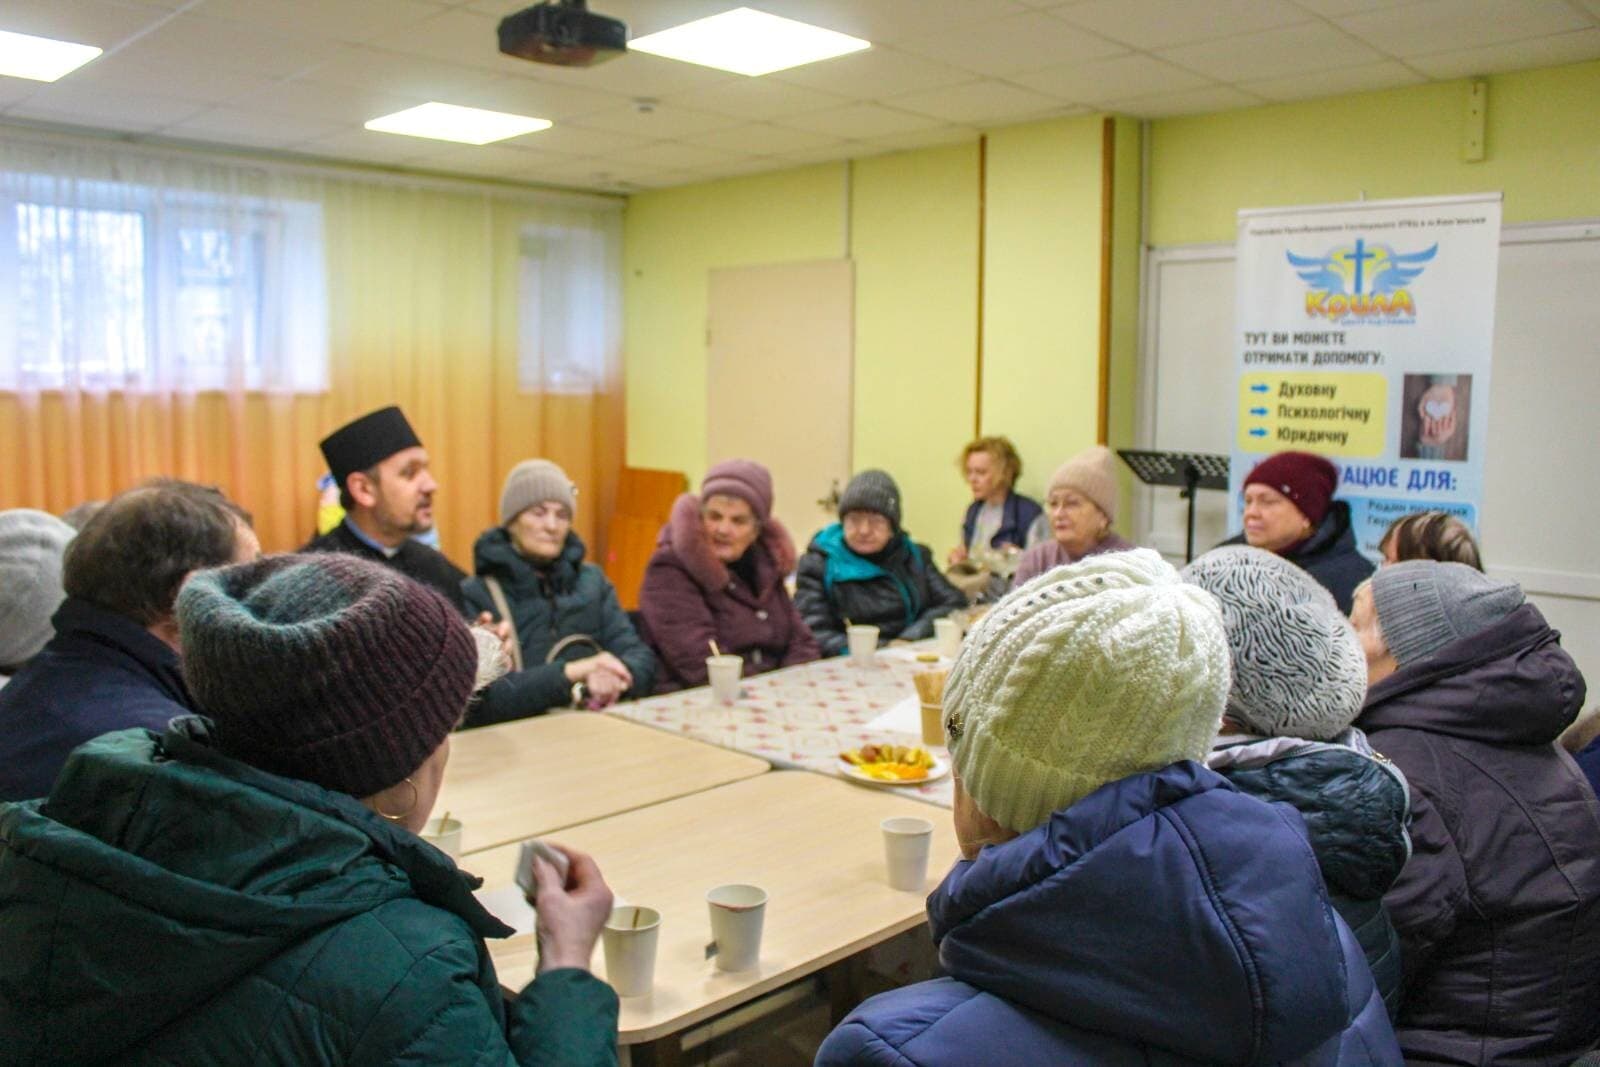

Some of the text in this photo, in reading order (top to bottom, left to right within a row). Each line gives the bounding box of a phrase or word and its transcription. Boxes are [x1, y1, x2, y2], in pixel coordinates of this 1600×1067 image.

[1245, 331, 1346, 345] ТУТ ВИ МОЖЕТЕ
[1244, 350, 1309, 364] ОТРИМАТИ
[1278, 382, 1337, 399] Духовну
[1277, 404, 1371, 424] Психологічну
[1276, 427, 1349, 446] Юридичну
[1407, 468, 1457, 491] ДЛЯ:
